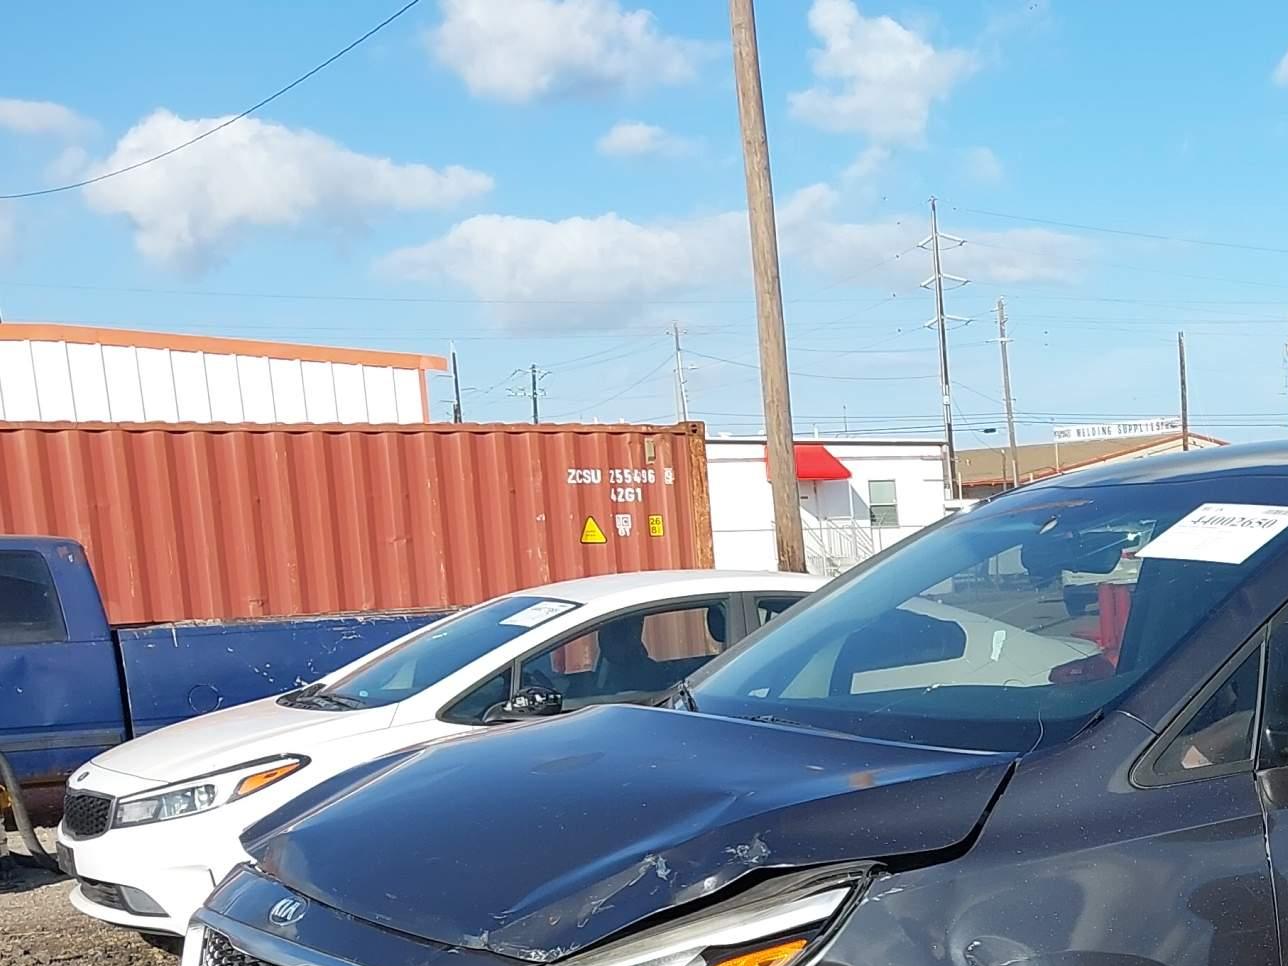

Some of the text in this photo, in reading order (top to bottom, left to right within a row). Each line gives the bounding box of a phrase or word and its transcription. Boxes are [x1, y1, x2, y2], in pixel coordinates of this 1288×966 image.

[1076, 425, 1112, 438] WELDING
[567, 468, 602, 484] ZCSU
[609, 468, 656, 484] 255496
[610, 487, 643, 503] 42G1
[1191, 514, 1278, 529] 44002650
[271, 898, 300, 921] KIA
